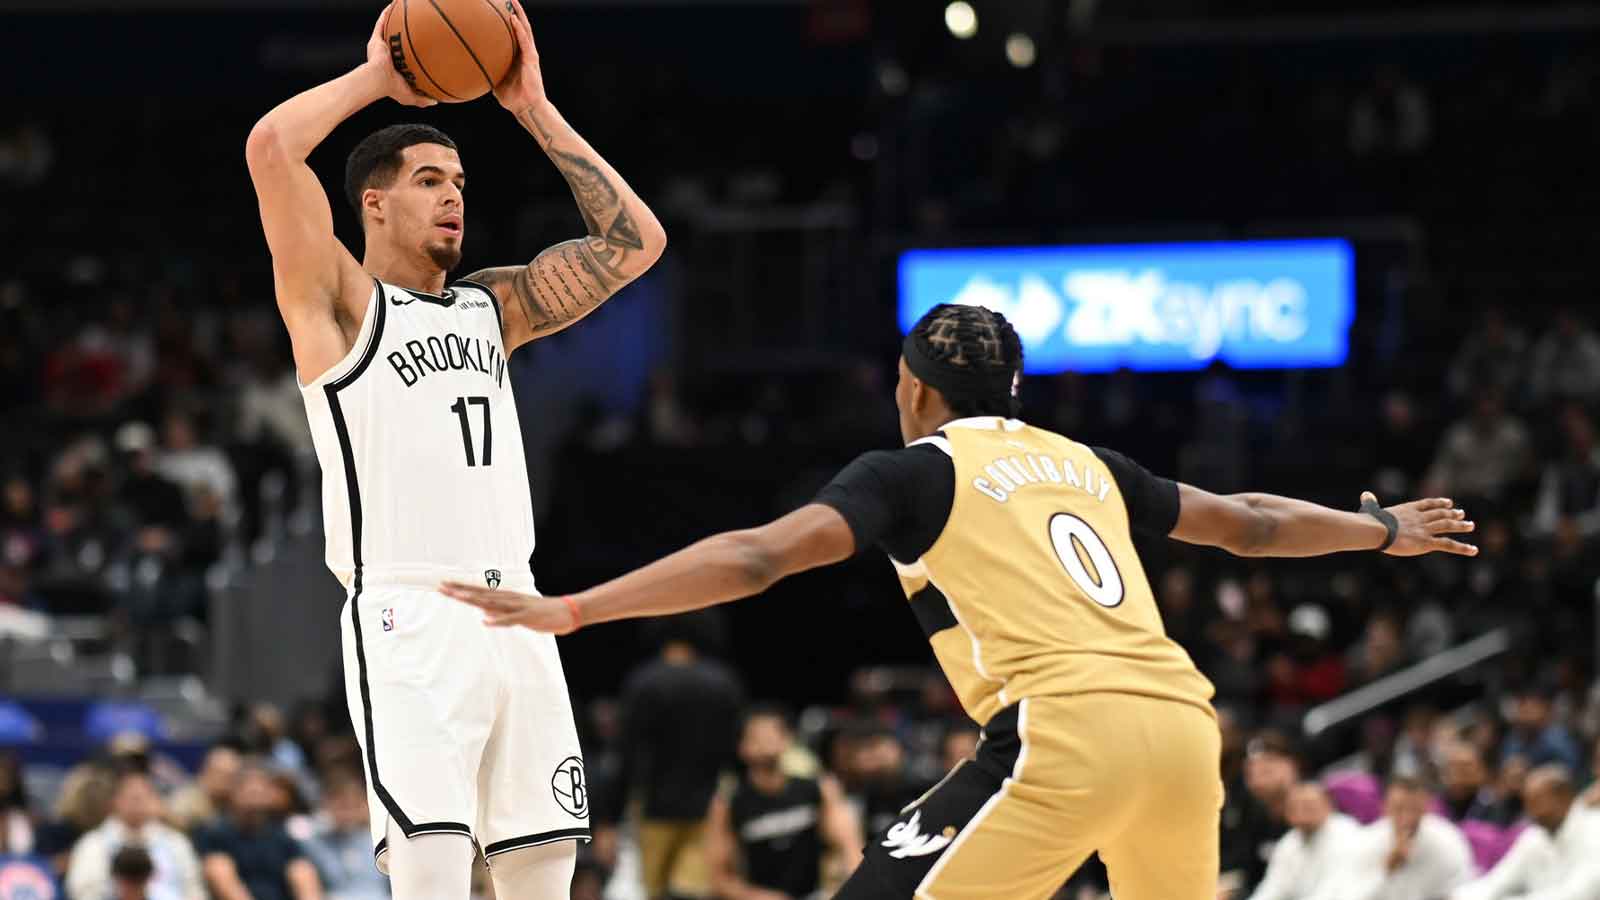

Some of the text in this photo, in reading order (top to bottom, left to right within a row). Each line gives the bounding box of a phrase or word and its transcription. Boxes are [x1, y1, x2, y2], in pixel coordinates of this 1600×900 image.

[387, 333, 504, 388] BROOKLYN
[451, 397, 492, 466] 17
[973, 453, 1110, 502] COULIBALY
[1048, 512, 1125, 608] 0
[570, 766, 584, 809] B
